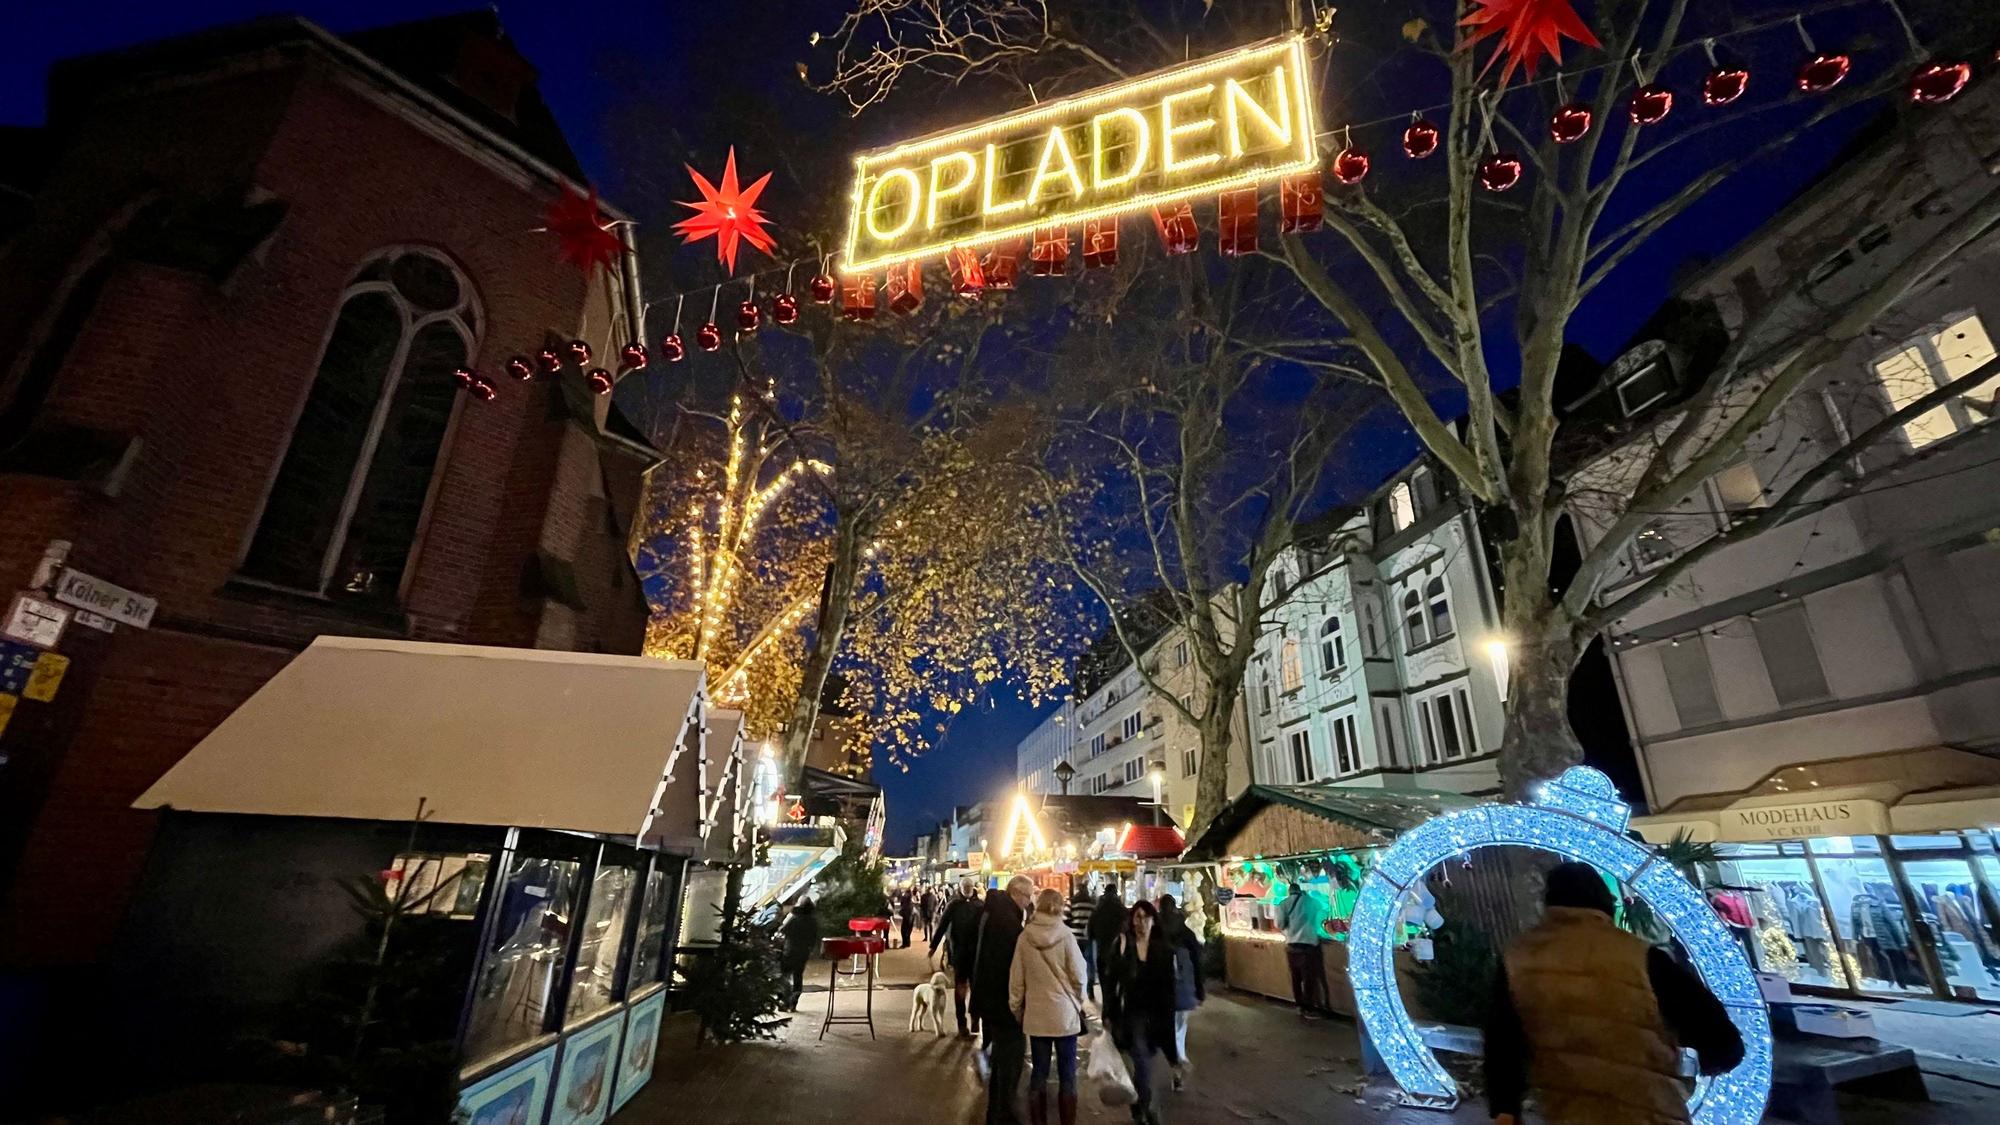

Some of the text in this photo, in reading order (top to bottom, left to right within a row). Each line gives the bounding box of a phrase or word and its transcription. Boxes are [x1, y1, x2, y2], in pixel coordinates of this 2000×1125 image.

[865, 65, 1292, 241] OPLADEN
[64, 575, 120, 610] Kölner
[1739, 804, 1851, 826] MODEHAUS
